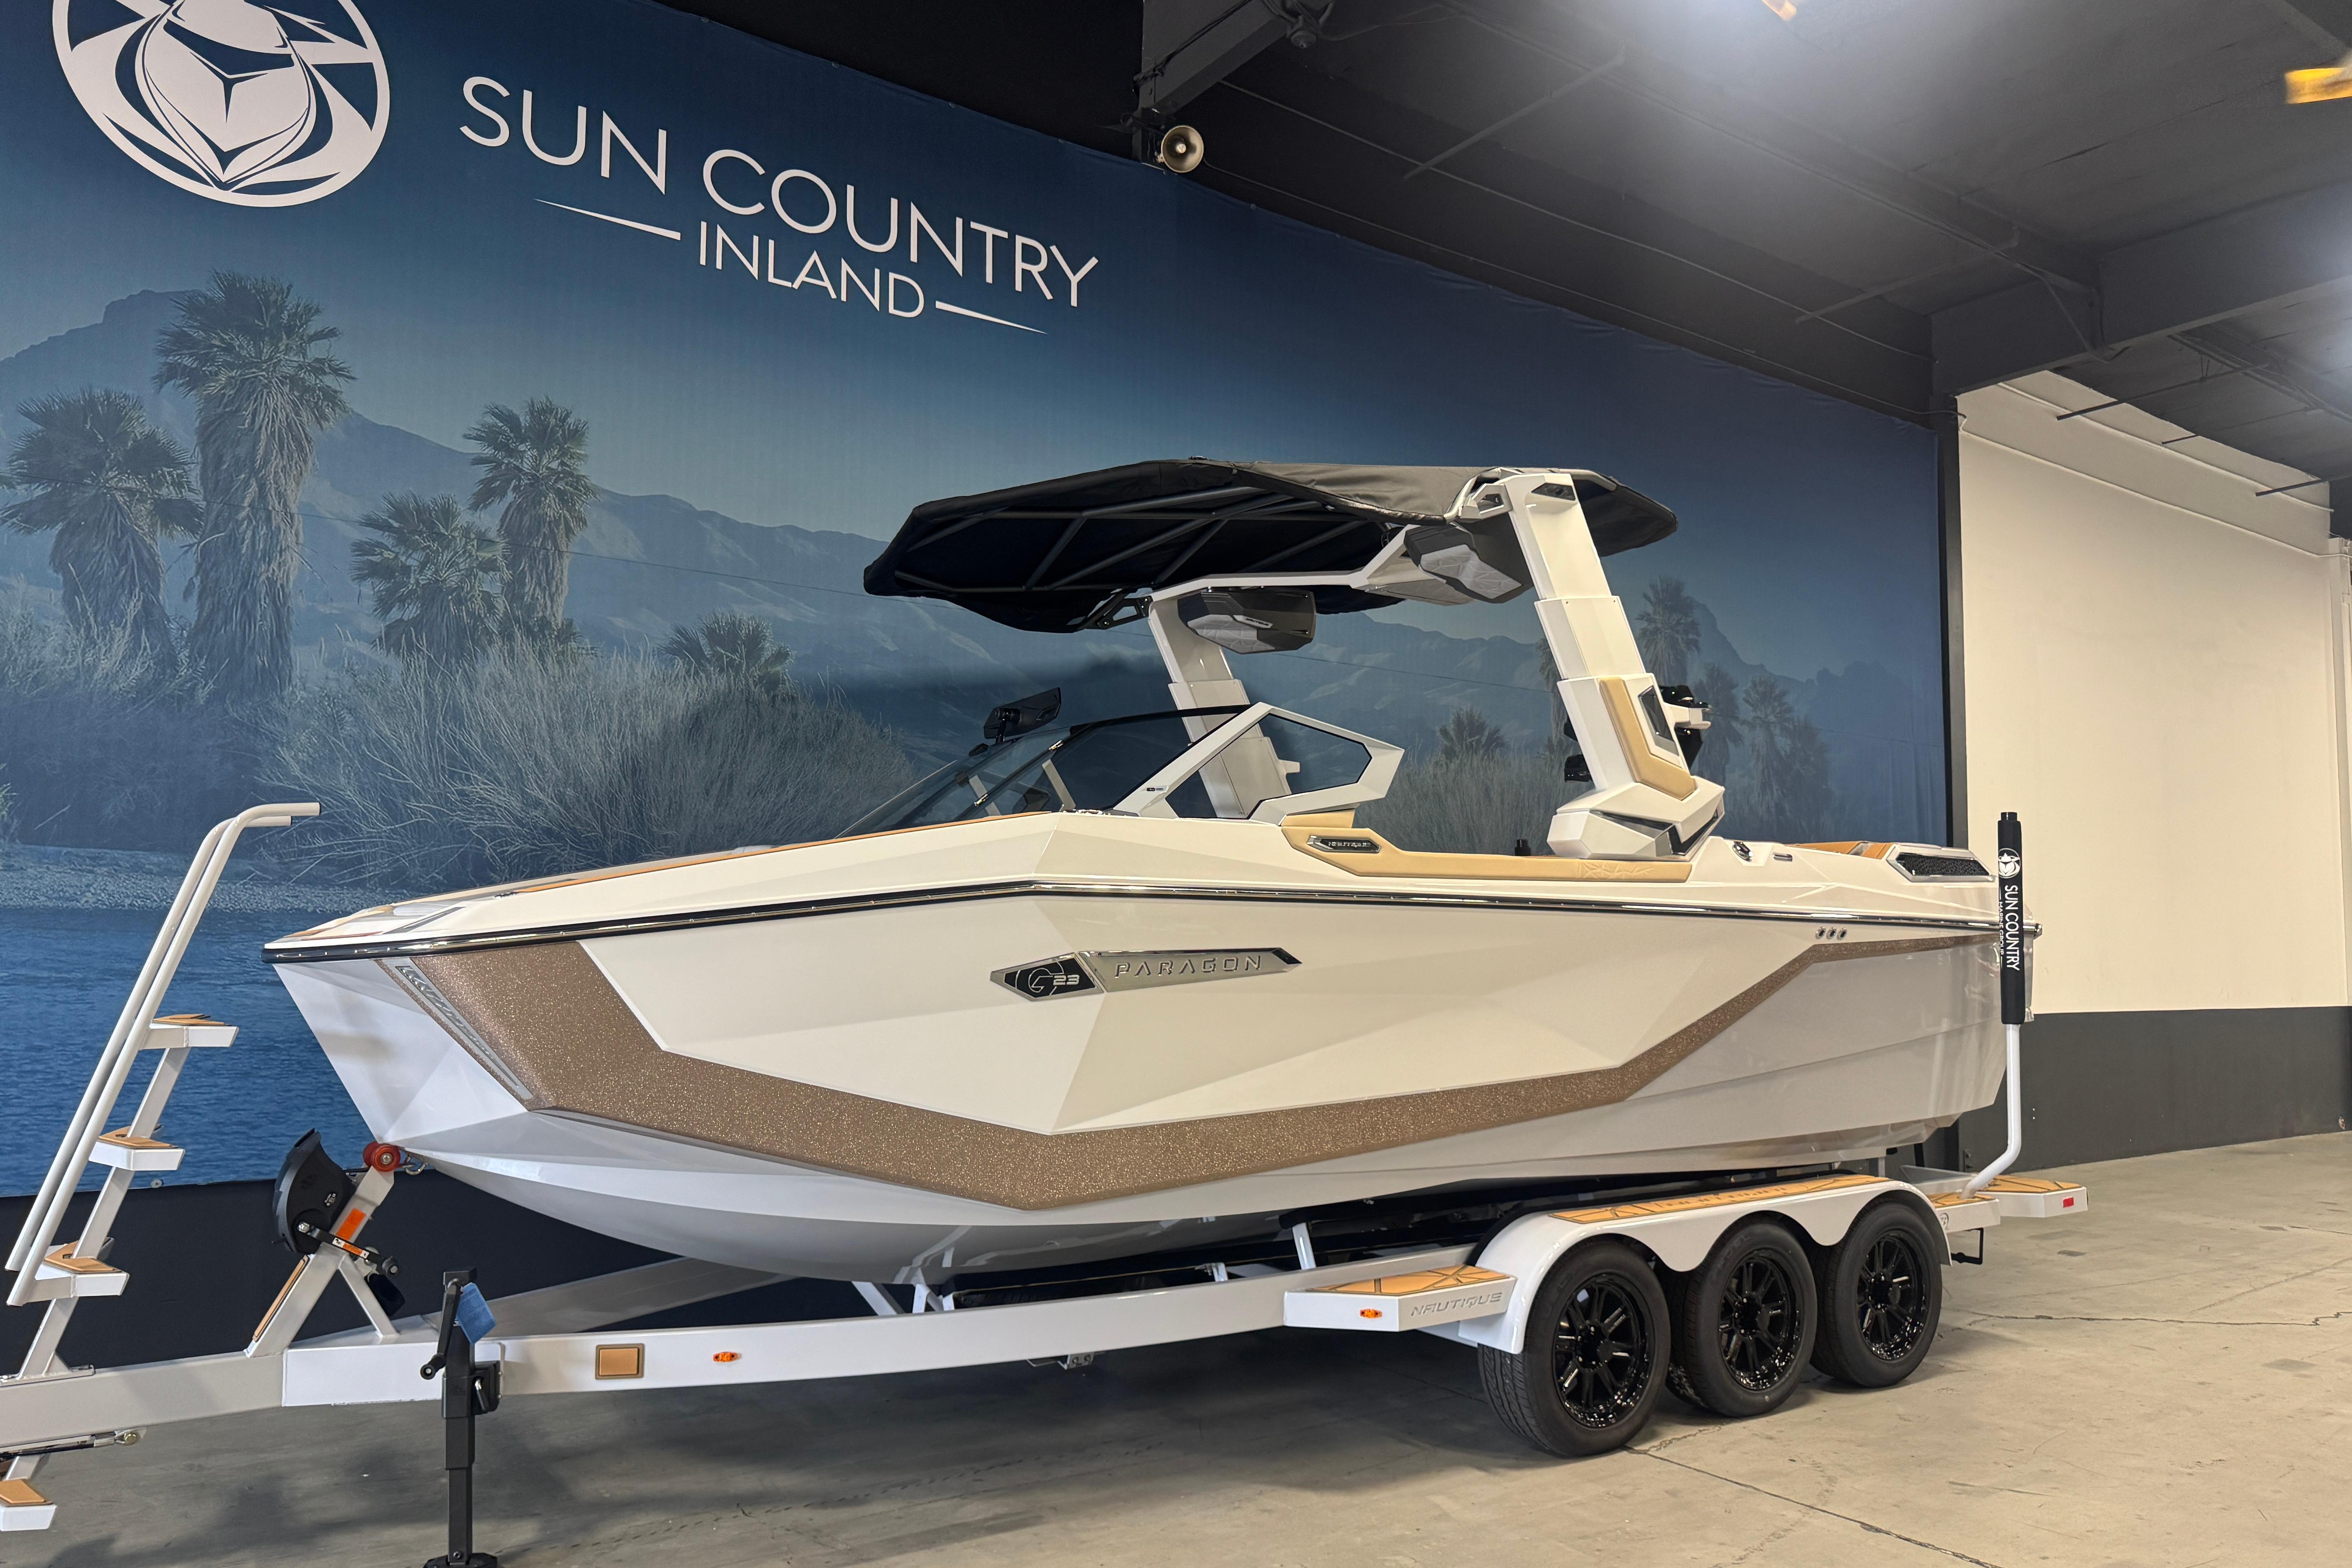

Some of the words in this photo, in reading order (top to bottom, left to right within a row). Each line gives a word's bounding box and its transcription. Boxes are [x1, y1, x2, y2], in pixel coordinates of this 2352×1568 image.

[459, 76, 667, 195] SUN
[702, 149, 1099, 307] COUNTRY
[699, 221, 924, 318] INLAND
[2004, 885, 2018, 910] SUN
[2005, 912, 2020, 971] COUNTRY
[1114, 955, 1261, 978] PARAGON
[1410, 1292, 1502, 1316] NAUTIQUE
